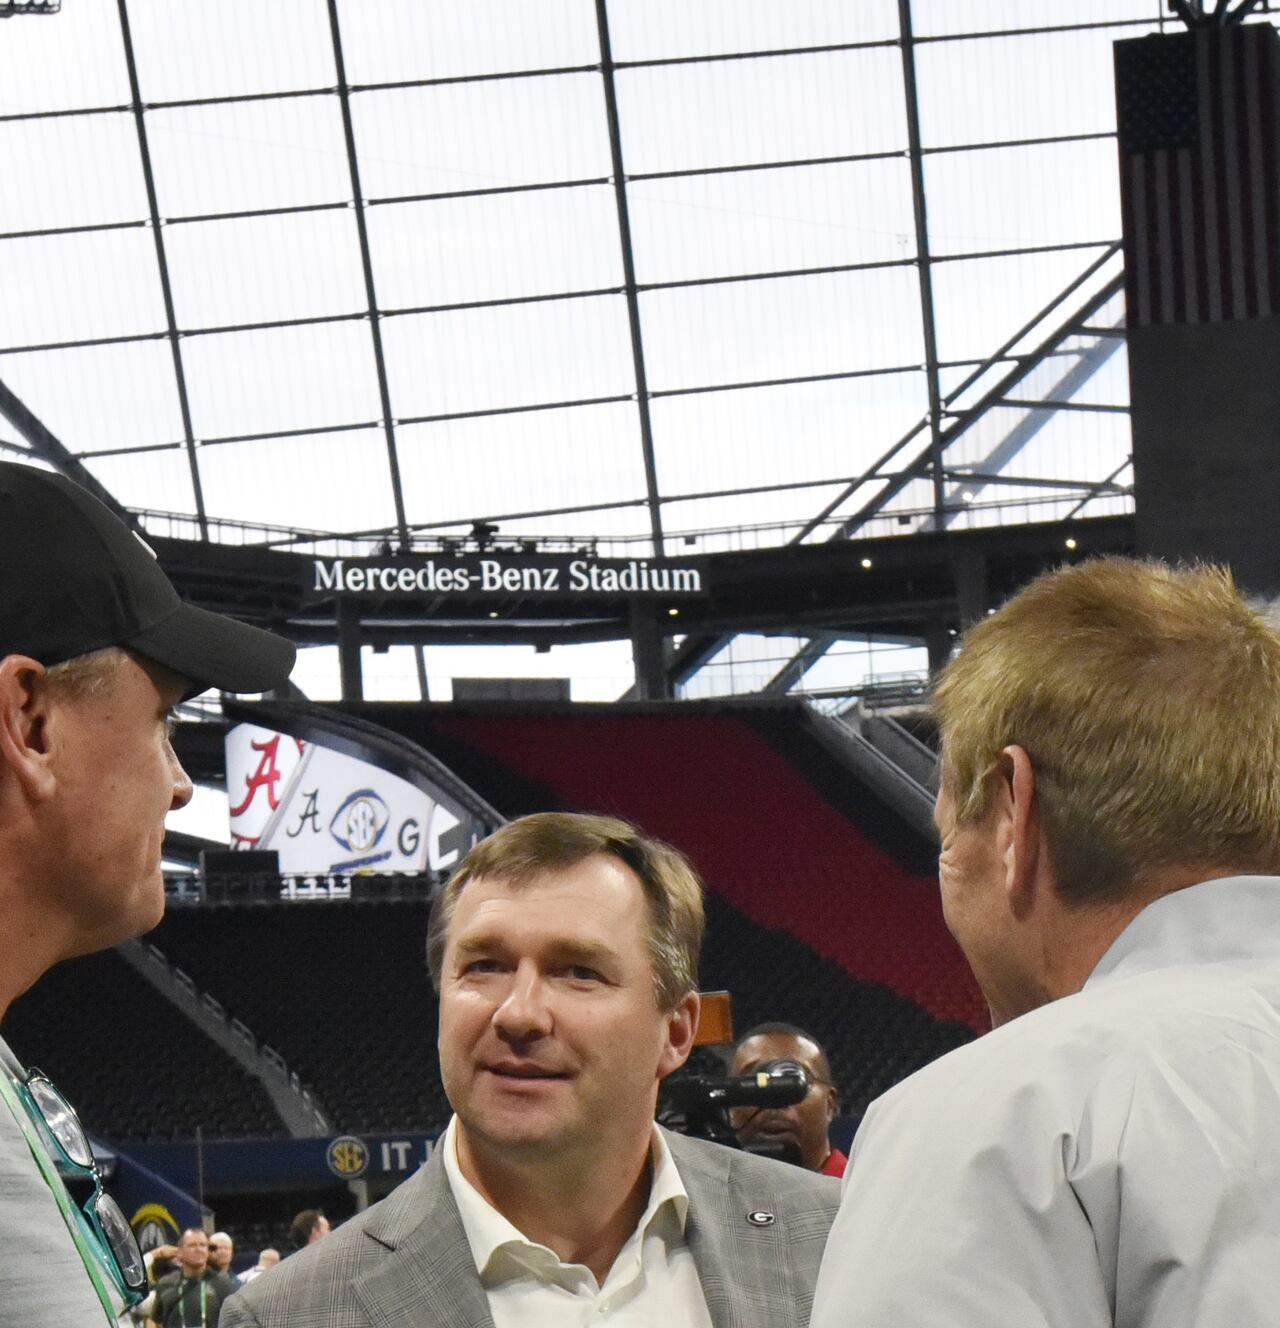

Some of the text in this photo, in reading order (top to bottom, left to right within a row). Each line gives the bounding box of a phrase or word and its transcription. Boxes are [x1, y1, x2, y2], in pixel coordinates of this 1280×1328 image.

[312, 559, 702, 592] Mercedes-Benz Stadium
[397, 817, 420, 857] G
[381, 1141, 412, 1171] IT
